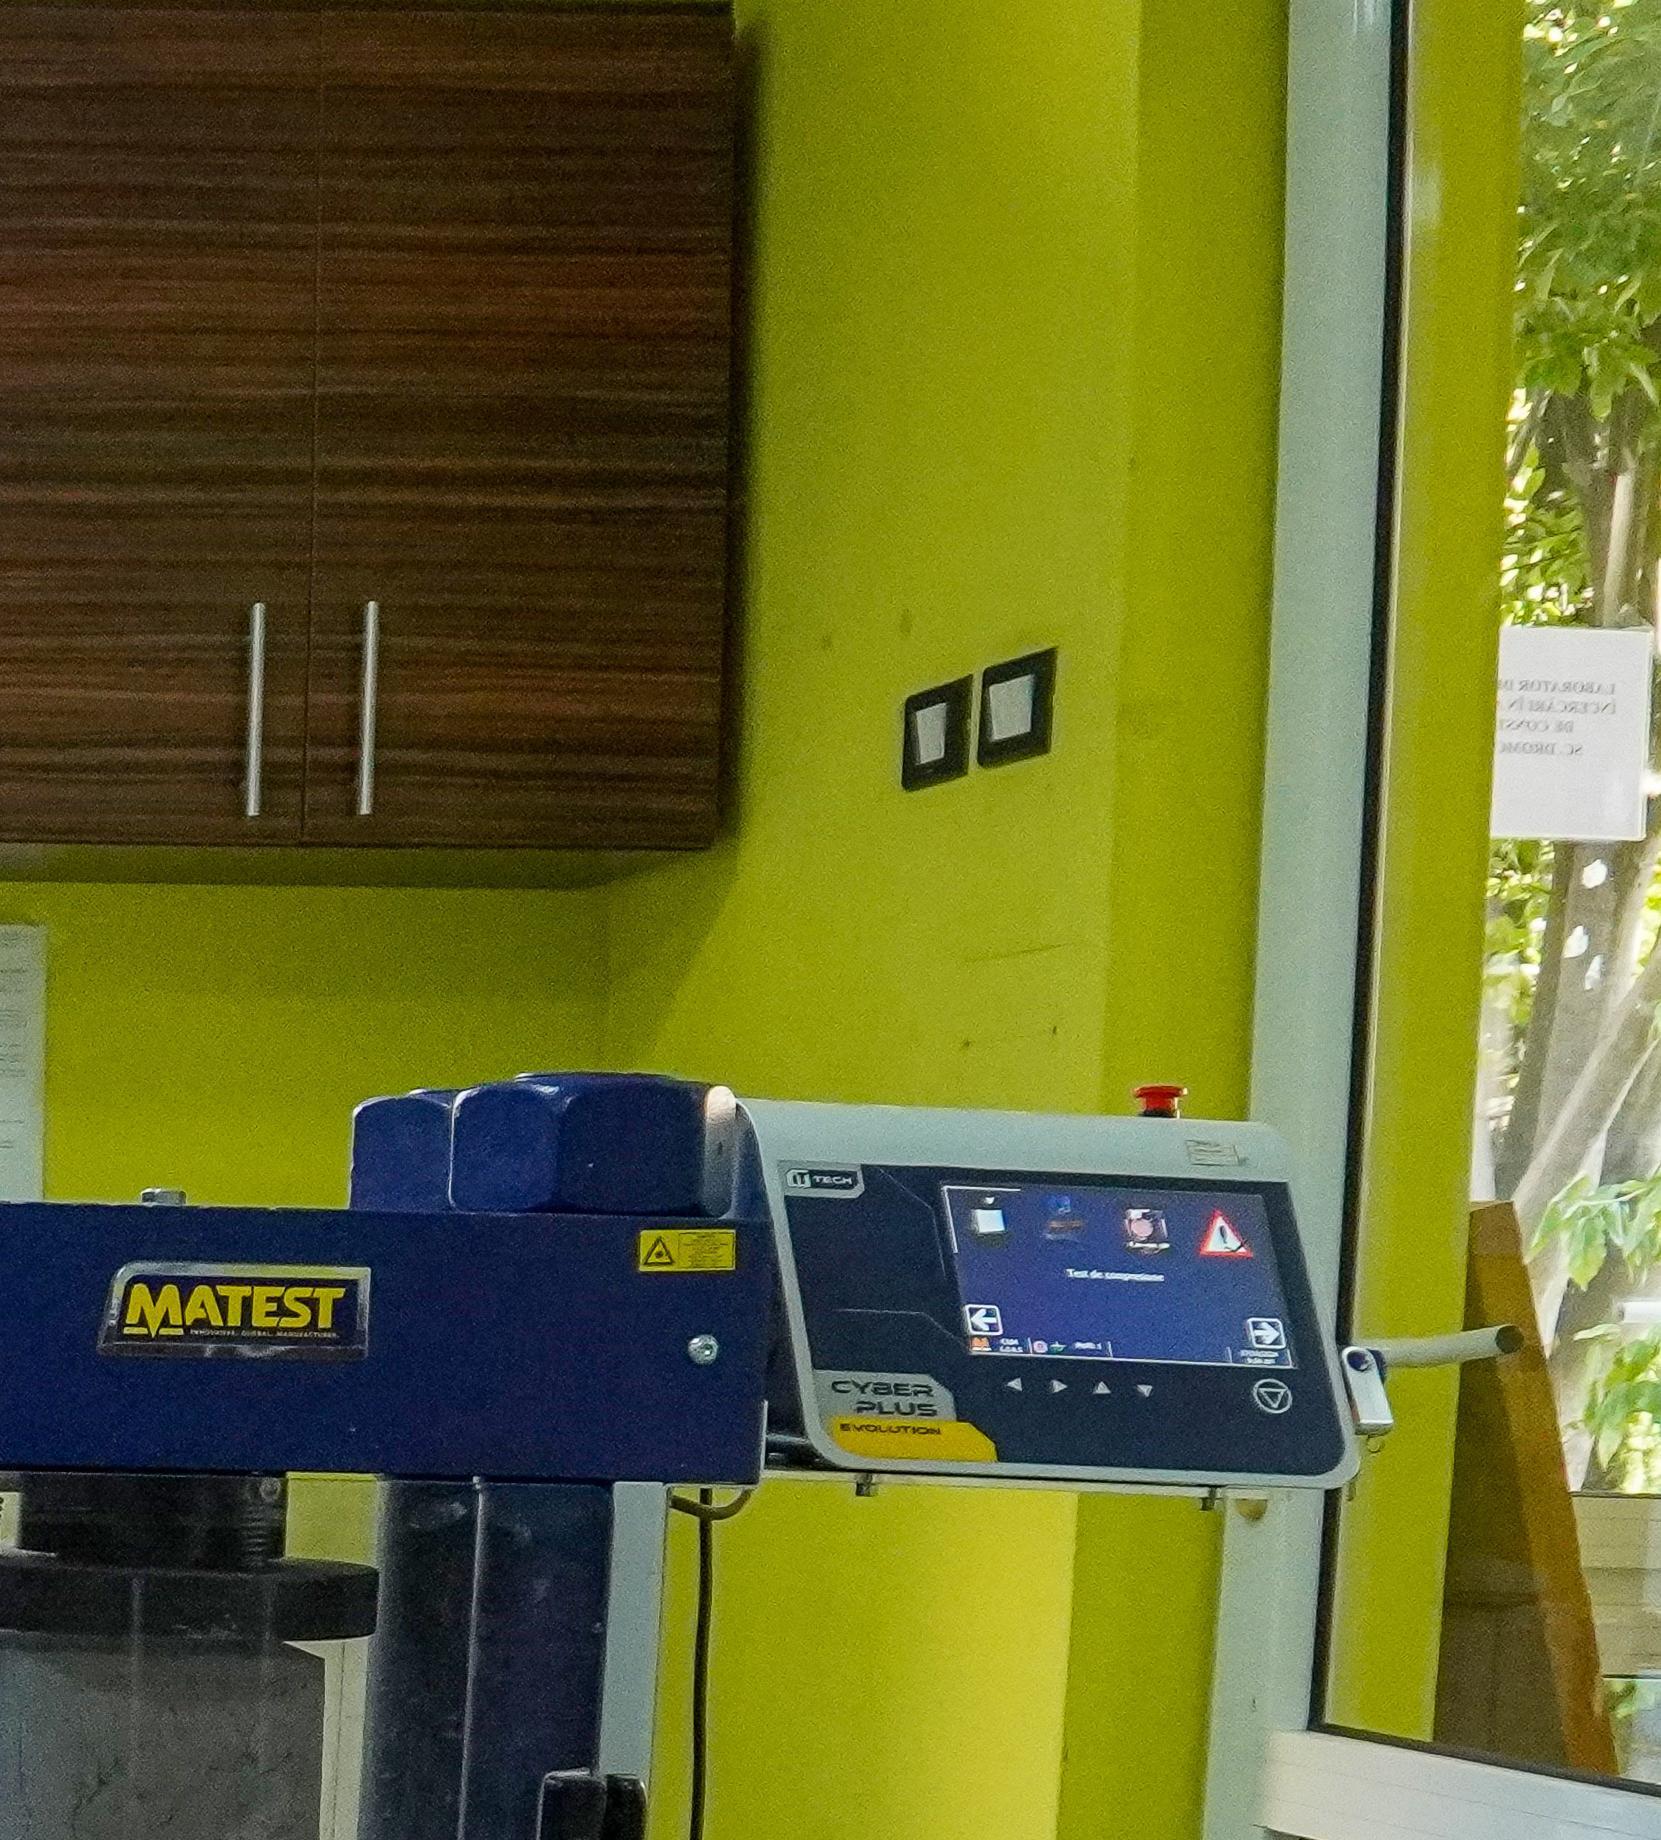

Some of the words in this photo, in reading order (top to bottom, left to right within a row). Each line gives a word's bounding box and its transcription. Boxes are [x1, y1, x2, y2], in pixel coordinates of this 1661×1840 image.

[812, 1175, 853, 1185] TECH
[124, 1283, 346, 1338] MATEST
[831, 1379, 934, 1397] CYBER
[855, 1400, 938, 1417] PLUS
[839, 1423, 941, 1435] EVOLUTION
